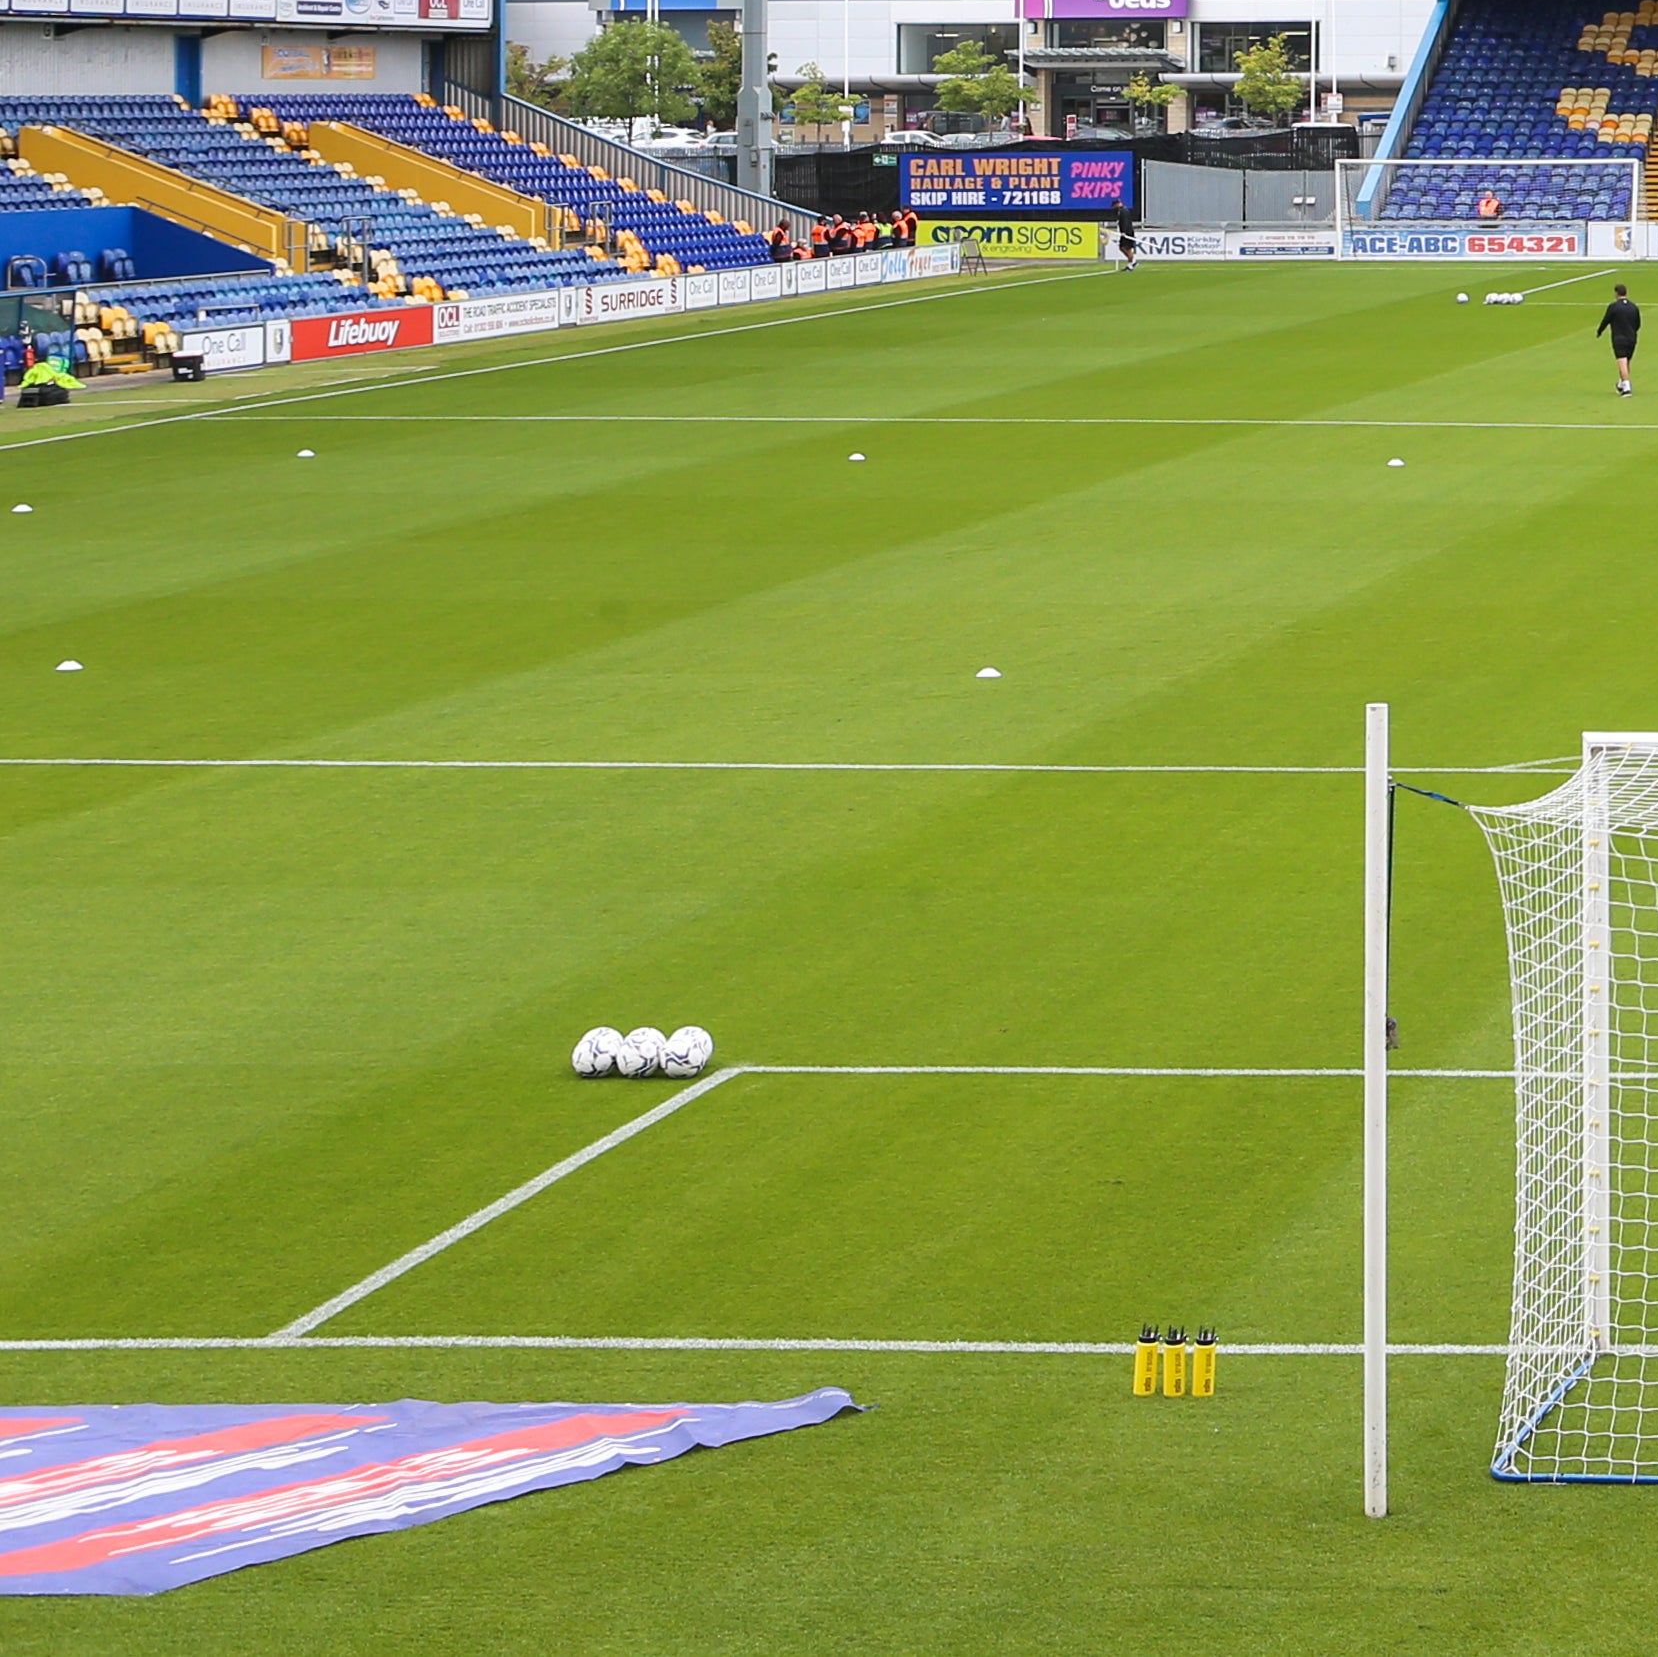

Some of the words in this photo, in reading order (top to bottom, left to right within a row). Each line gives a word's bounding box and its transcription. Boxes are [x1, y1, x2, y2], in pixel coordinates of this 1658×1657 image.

[910, 158, 966, 176] CARL
[973, 158, 1062, 176] WRIGHT
[1070, 161, 1125, 179] PINKY
[910, 177, 984, 190] HAULAGE
[991, 177, 1003, 190] &
[1009, 177, 1061, 189] PLANT
[1071, 181, 1124, 199] SKIPS
[910, 191, 948, 206] SKIP
[951, 192, 986, 206] HIRE
[1002, 191, 1061, 205] 721168
[1017, 219, 1082, 251] signs
[1053, 245, 1068, 253] LTD
[1354, 236, 1458, 254] ACE-ABC
[1466, 235, 1577, 255] 654321
[601, 288, 664, 312] SURRIDGE
[438, 305, 460, 328] OCL
[328, 317, 401, 347] Lifebuoy
[202, 332, 224, 355] One
[226, 331, 246, 352] Call
